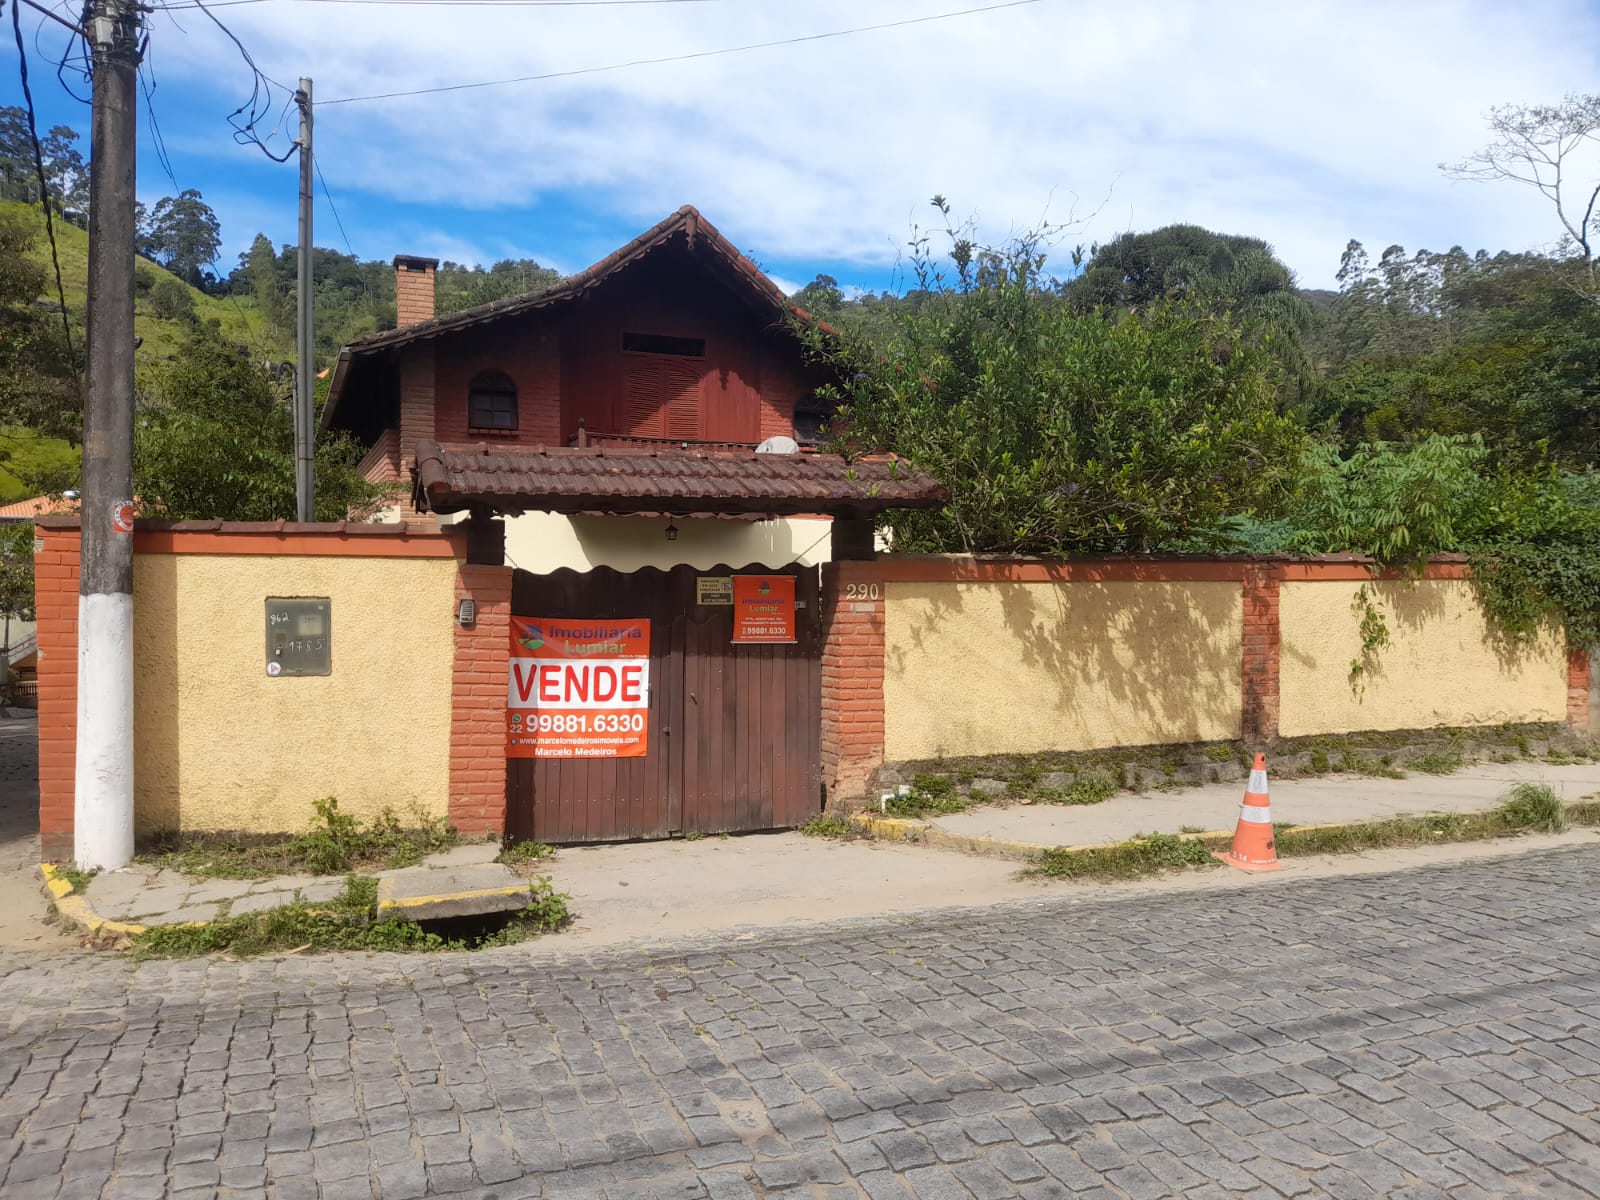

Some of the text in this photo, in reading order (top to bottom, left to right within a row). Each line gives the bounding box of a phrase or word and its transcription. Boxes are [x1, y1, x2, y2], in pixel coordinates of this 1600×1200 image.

[846, 583, 879, 600] 290
[565, 640, 626, 654] Lumiar
[513, 663, 642, 702] VENDE
[510, 714, 643, 733] 22 99881.6330
[520, 736, 640, 745] www.marcelomedeirosimoveis.com
[535, 747, 617, 756] Marcelo Medeiros
